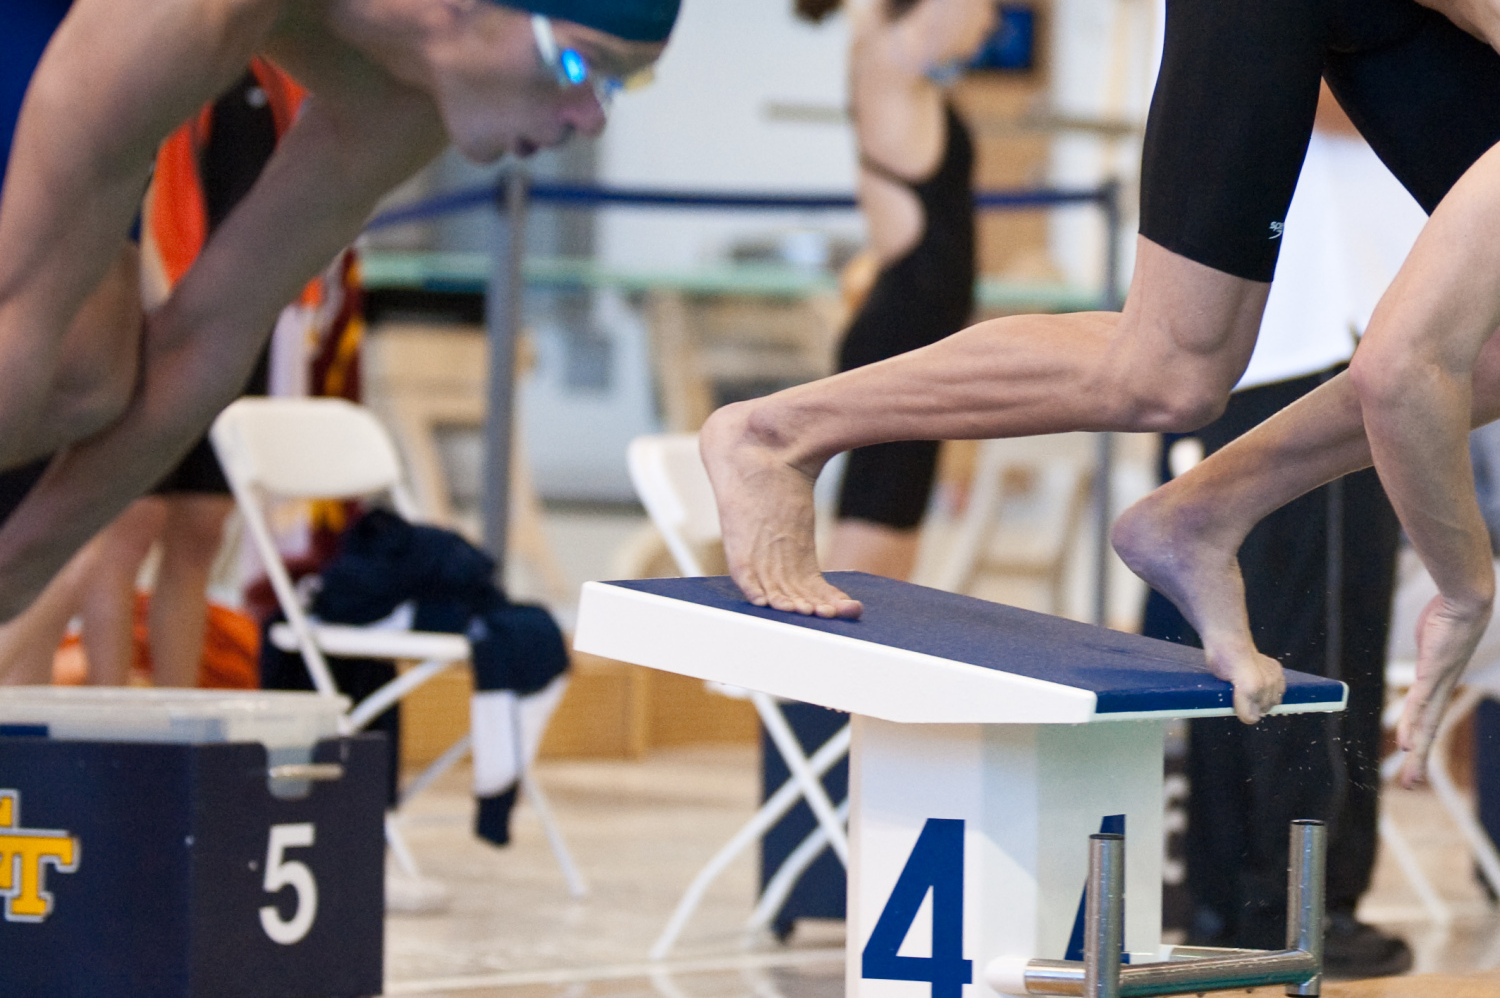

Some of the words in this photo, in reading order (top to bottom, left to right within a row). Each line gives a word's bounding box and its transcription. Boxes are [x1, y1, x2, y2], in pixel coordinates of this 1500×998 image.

[0, 789, 81, 923] T
[259, 823, 317, 945] 5
[862, 818, 973, 998] 4
